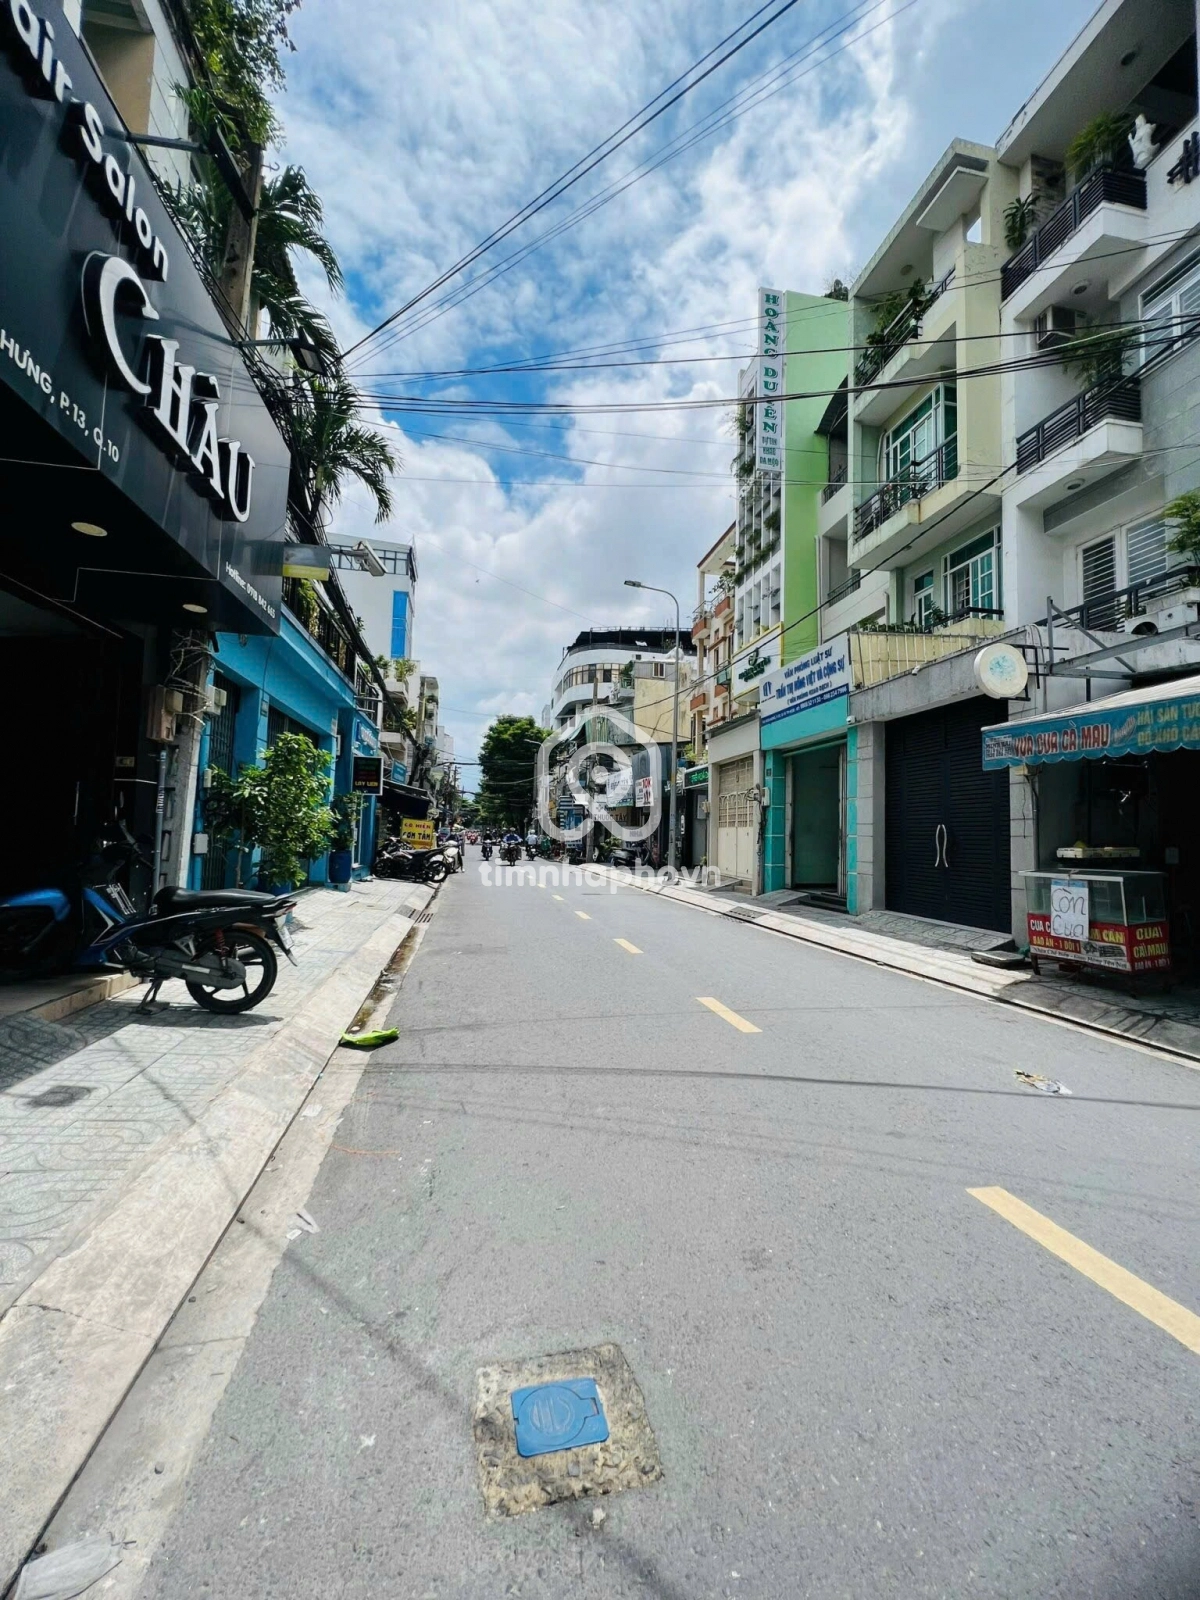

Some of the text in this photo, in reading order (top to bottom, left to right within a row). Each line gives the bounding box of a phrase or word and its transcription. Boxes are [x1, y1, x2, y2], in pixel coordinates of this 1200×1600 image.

[79, 103, 168, 282] Salon
[0, 328, 119, 462] HƯNG, P.13, Q.10
[811, 652, 824, 665] LUẬT
[824, 646, 833, 659] SƯ
[1036, 729, 1059, 755] CUA
[1062, 720, 1078, 752] CÀ
[1081, 723, 1111, 750] MAU
[1052, 888, 1086, 916] Còn
[1030, 919, 1044, 932] CUA
[1053, 915, 1084, 938] Cua
[1135, 926, 1163, 940] CUA
